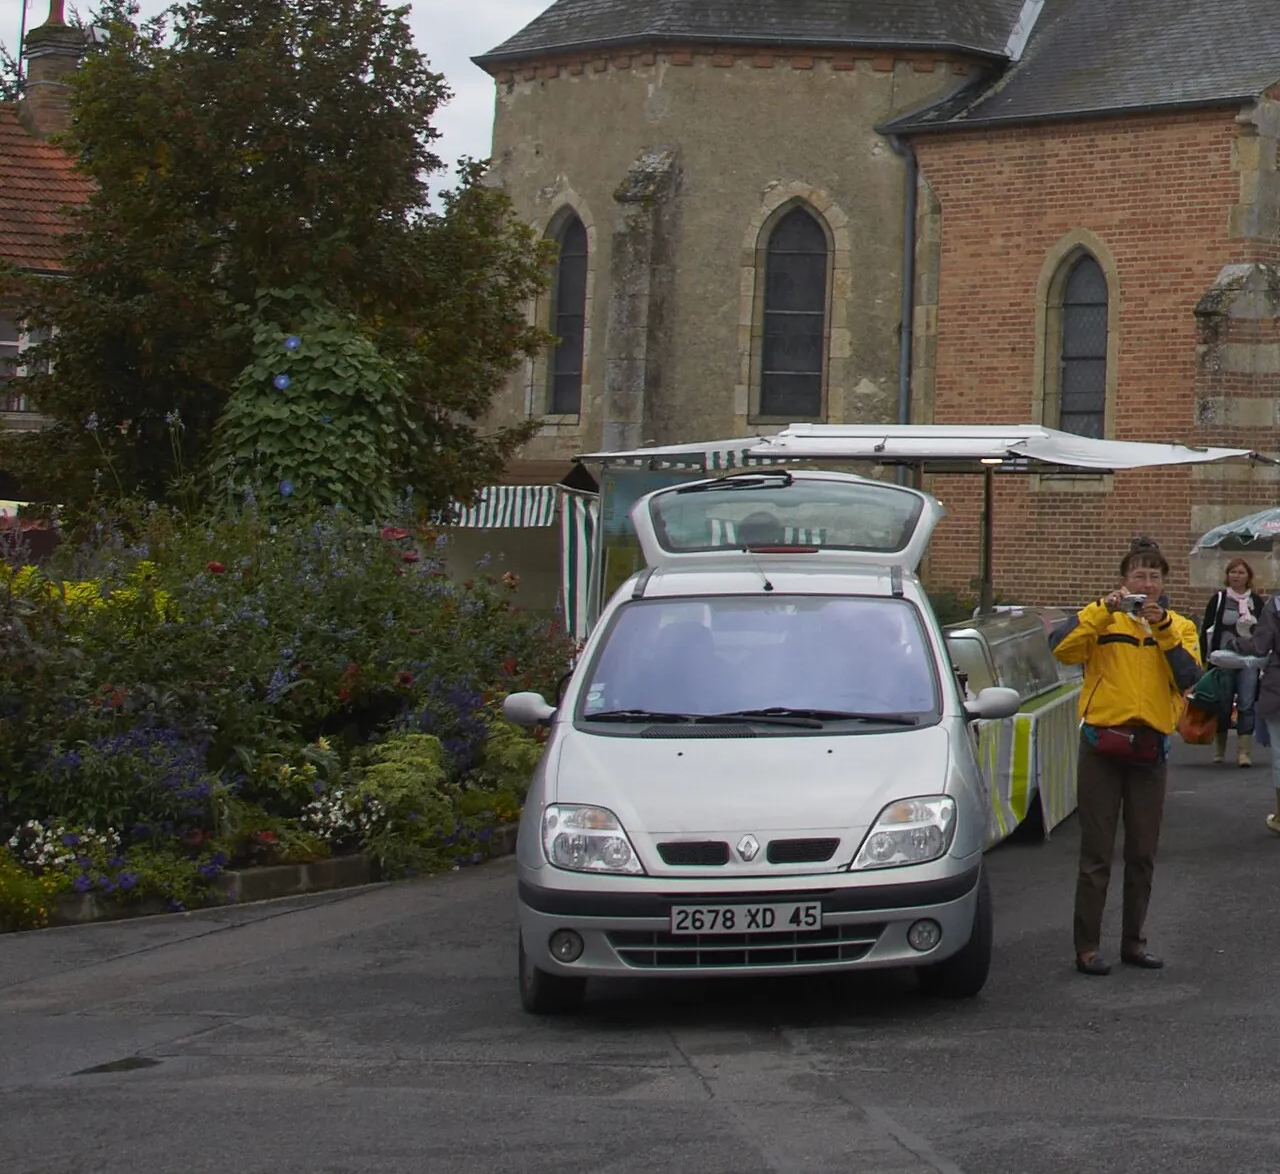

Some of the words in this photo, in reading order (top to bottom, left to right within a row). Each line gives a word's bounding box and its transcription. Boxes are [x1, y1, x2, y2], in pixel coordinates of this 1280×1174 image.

[676, 909, 736, 930] 2678
[747, 908, 776, 928] XD
[789, 906, 817, 927] 45
